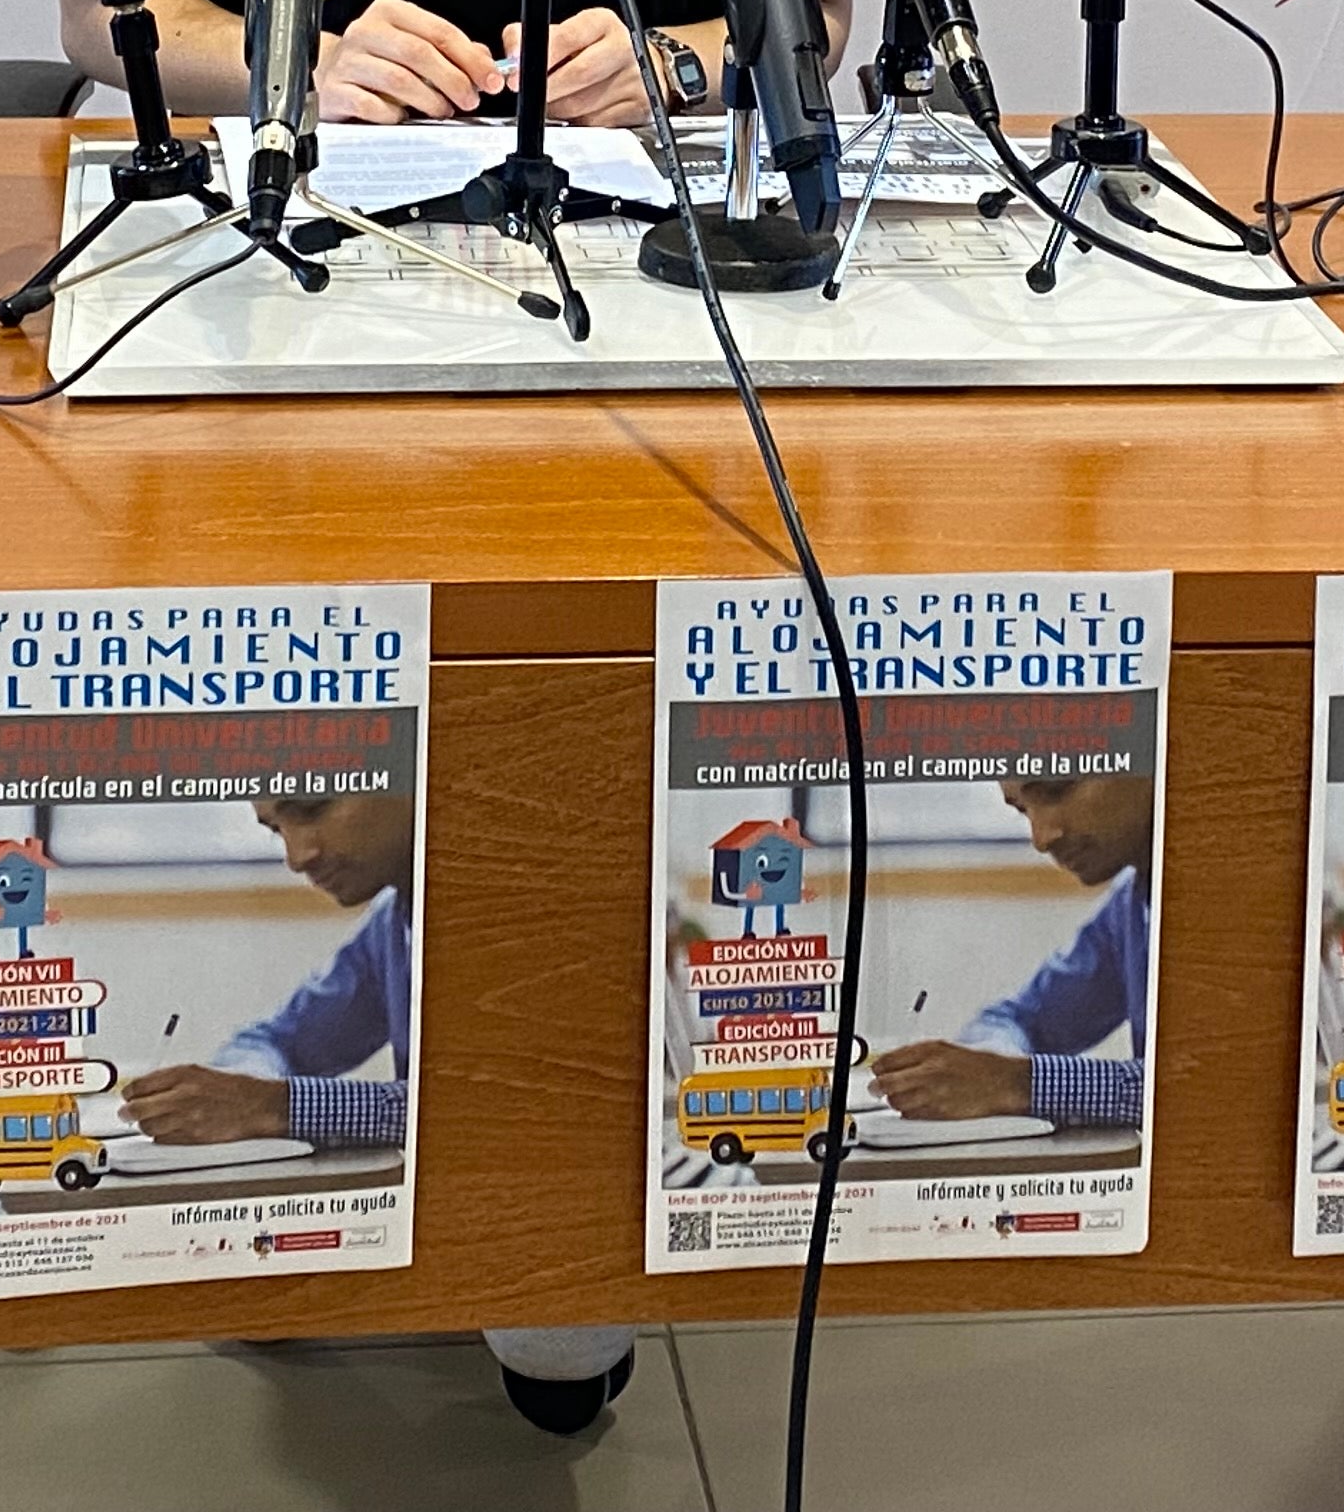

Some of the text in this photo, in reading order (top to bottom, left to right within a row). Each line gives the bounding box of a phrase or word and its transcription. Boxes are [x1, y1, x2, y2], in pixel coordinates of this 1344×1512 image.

[168, 607, 291, 628] PARA
[324, 606, 371, 626] EL
[718, 591, 1116, 619] AYUAS PARA EL
[686, 651, 1143, 696] Y EL TRANSPORTE
[50, 668, 400, 708] TRANSPORTE
[697, 763, 736, 784] con
[744, 758, 850, 782] matrícula
[894, 755, 914, 777] el
[922, 755, 1007, 781] campus
[1017, 754, 1043, 775] de
[1050, 753, 1070, 774] la
[1078, 753, 1131, 773] UCLM
[105, 779, 133, 798] en
[142, 774, 163, 797] el
[171, 774, 260, 801] campus
[270, 773, 297, 794] de
[304, 772, 325, 793] la
[334, 771, 389, 791] UCLM
[714, 941, 814, 962] EDICIÓN VII
[37, 964, 60, 981] VII
[692, 963, 835, 984] ALOJAMIENTO
[44, 1045, 60, 1062] III
[702, 1043, 835, 1064] TRANSPORTE
[917, 1174, 1134, 1202] infórmate y solicita tu ayuda
[172, 1191, 397, 1226] infórmate y solicita tu ayuda
